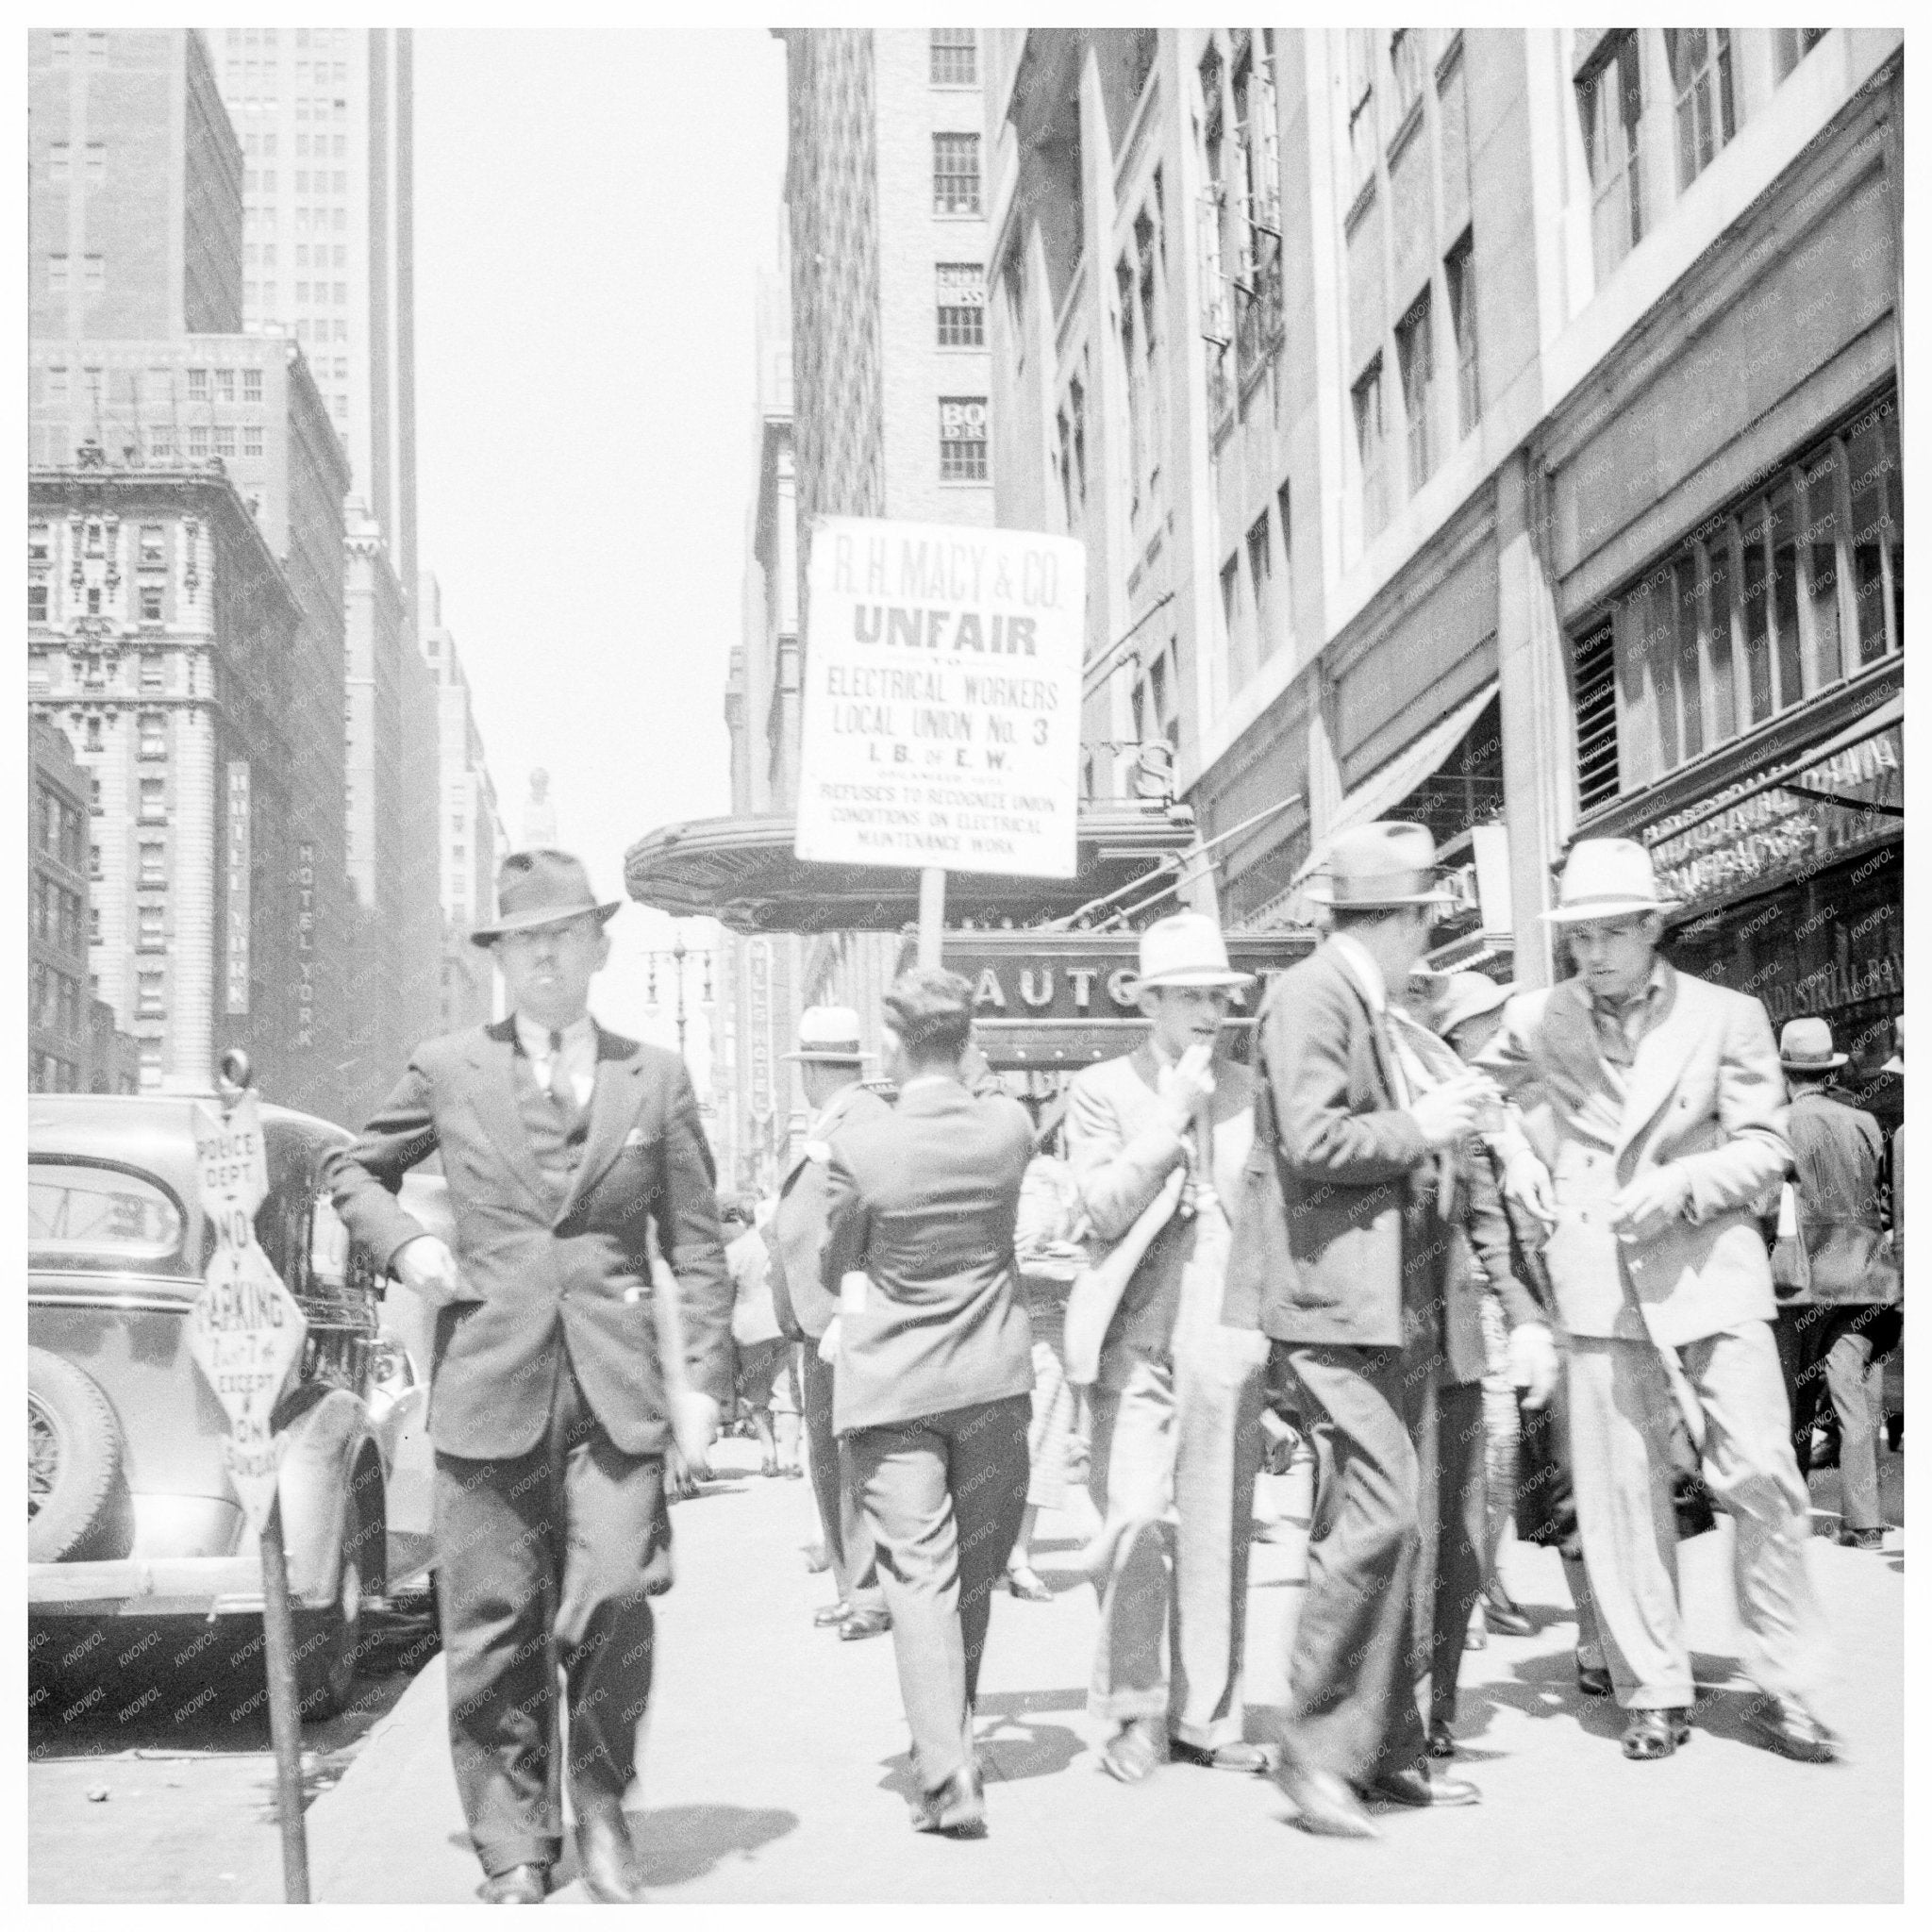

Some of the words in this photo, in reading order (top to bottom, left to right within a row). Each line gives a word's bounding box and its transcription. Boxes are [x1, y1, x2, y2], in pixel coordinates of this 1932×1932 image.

[900, 538, 988, 604] MACY
[993, 554, 1012, 601] &
[854, 604, 1037, 657] UNFAIR
[827, 665, 946, 703] ELECTRICAL
[963, 675, 1058, 711] WORKERS
[833, 704, 896, 736] LOCAL
[912, 708, 972, 742] UNION
[1033, 717, 1049, 746] 3
[955, 747, 974, 768] E.
[985, 750, 1013, 772] W.
[819, 783, 896, 803] REFUSES
[902, 787, 922, 804] TO
[926, 788, 1006, 810] RECOGNIZE
[1009, 794, 1057, 813] UNION
[830, 806, 921, 826] CONDITIONS
[928, 810, 949, 829] ON
[956, 812, 1042, 835] ELECTRICAL
[858, 830, 960, 851] MAINTENANCE
[970, 835, 1017, 856] WORK
[299, 844, 314, 951] HOTEL
[298, 961, 313, 1047] YORK
[195, 1132, 256, 1163] POLICE
[219, 1208, 247, 1249] NO
[197, 1281, 284, 1334] PARKING
[218, 1374, 275, 1394] EXCEPT
[237, 1419, 263, 1444] ON
[225, 1445, 278, 1478] SUNDAY
